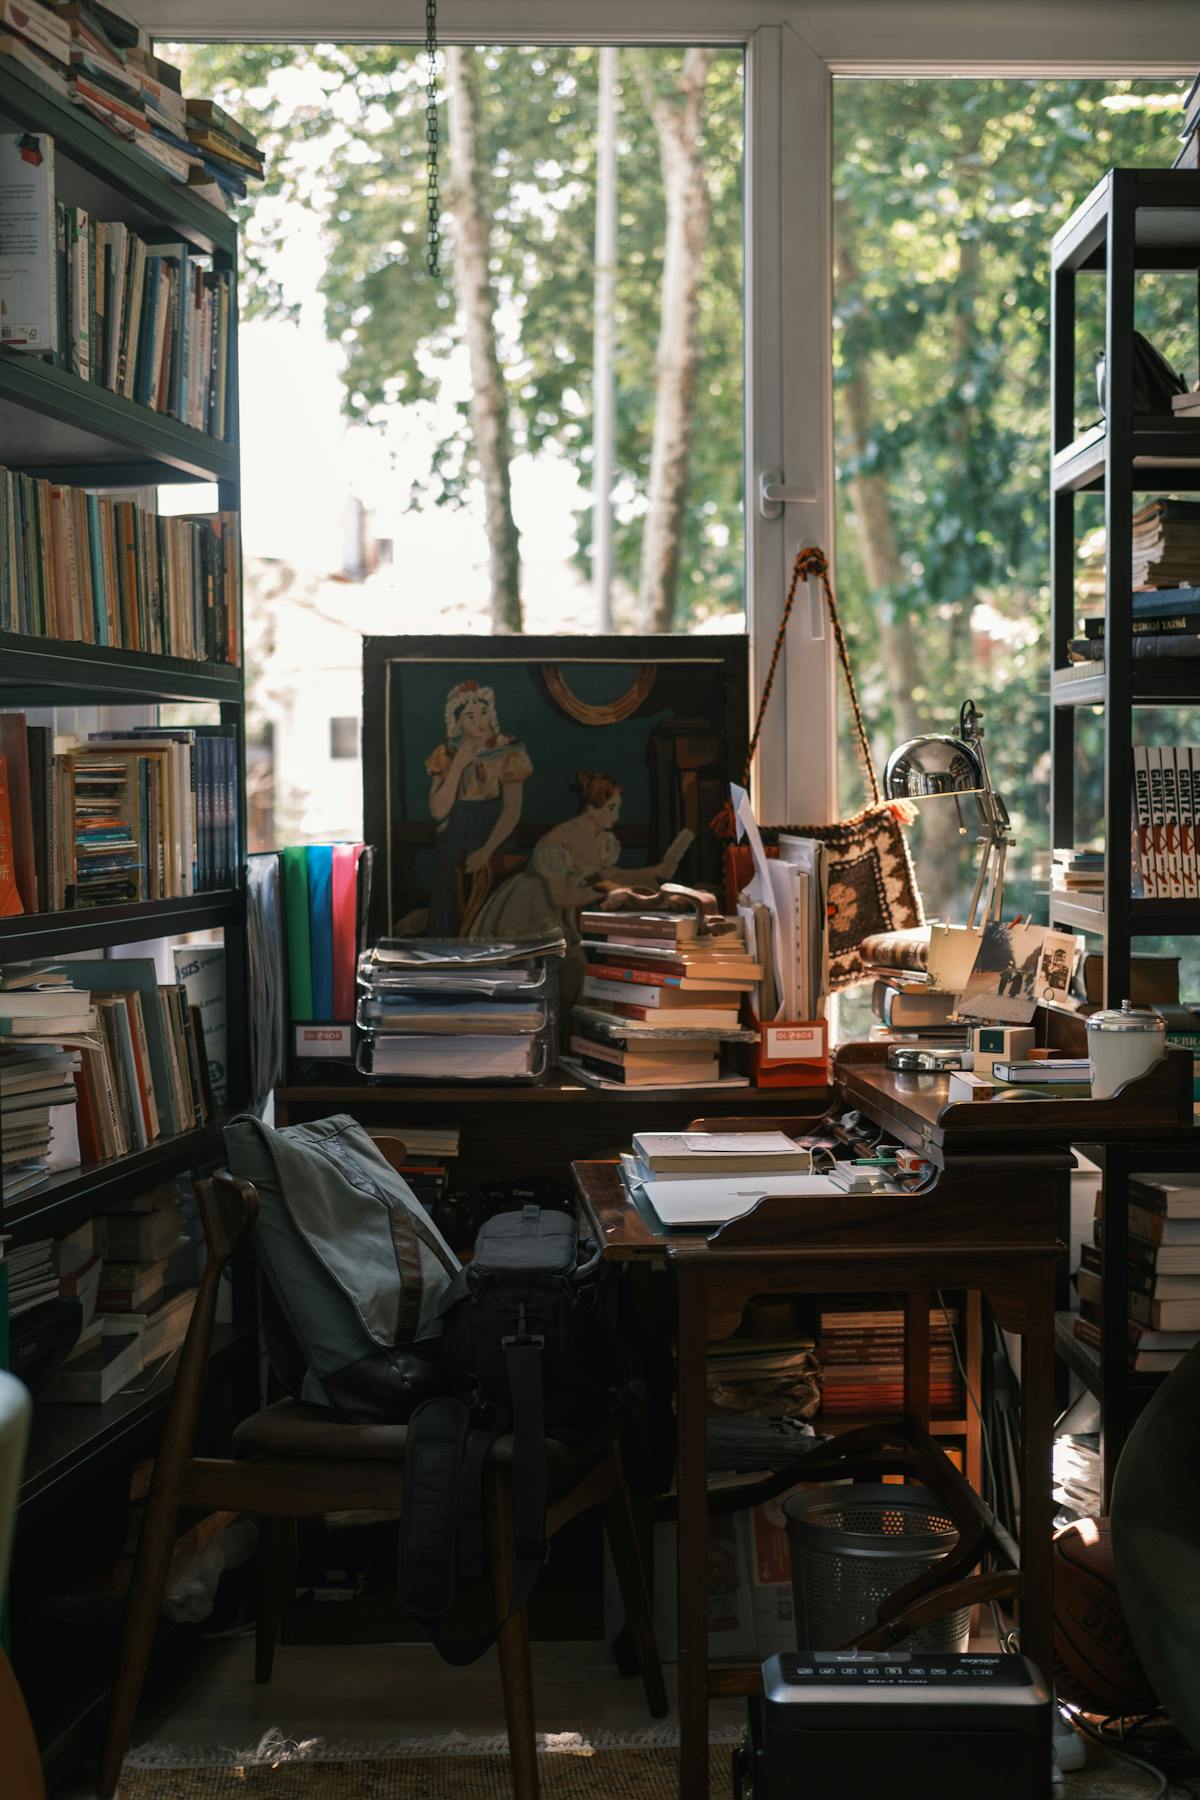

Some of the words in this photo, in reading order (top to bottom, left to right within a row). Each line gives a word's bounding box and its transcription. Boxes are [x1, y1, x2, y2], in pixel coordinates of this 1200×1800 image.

[1137, 770, 1150, 814] GANTZ
[1150, 769, 1163, 813] GANTZ
[1163, 769, 1177, 813] GANTZ
[1179, 769, 1192, 814] GANTZ
